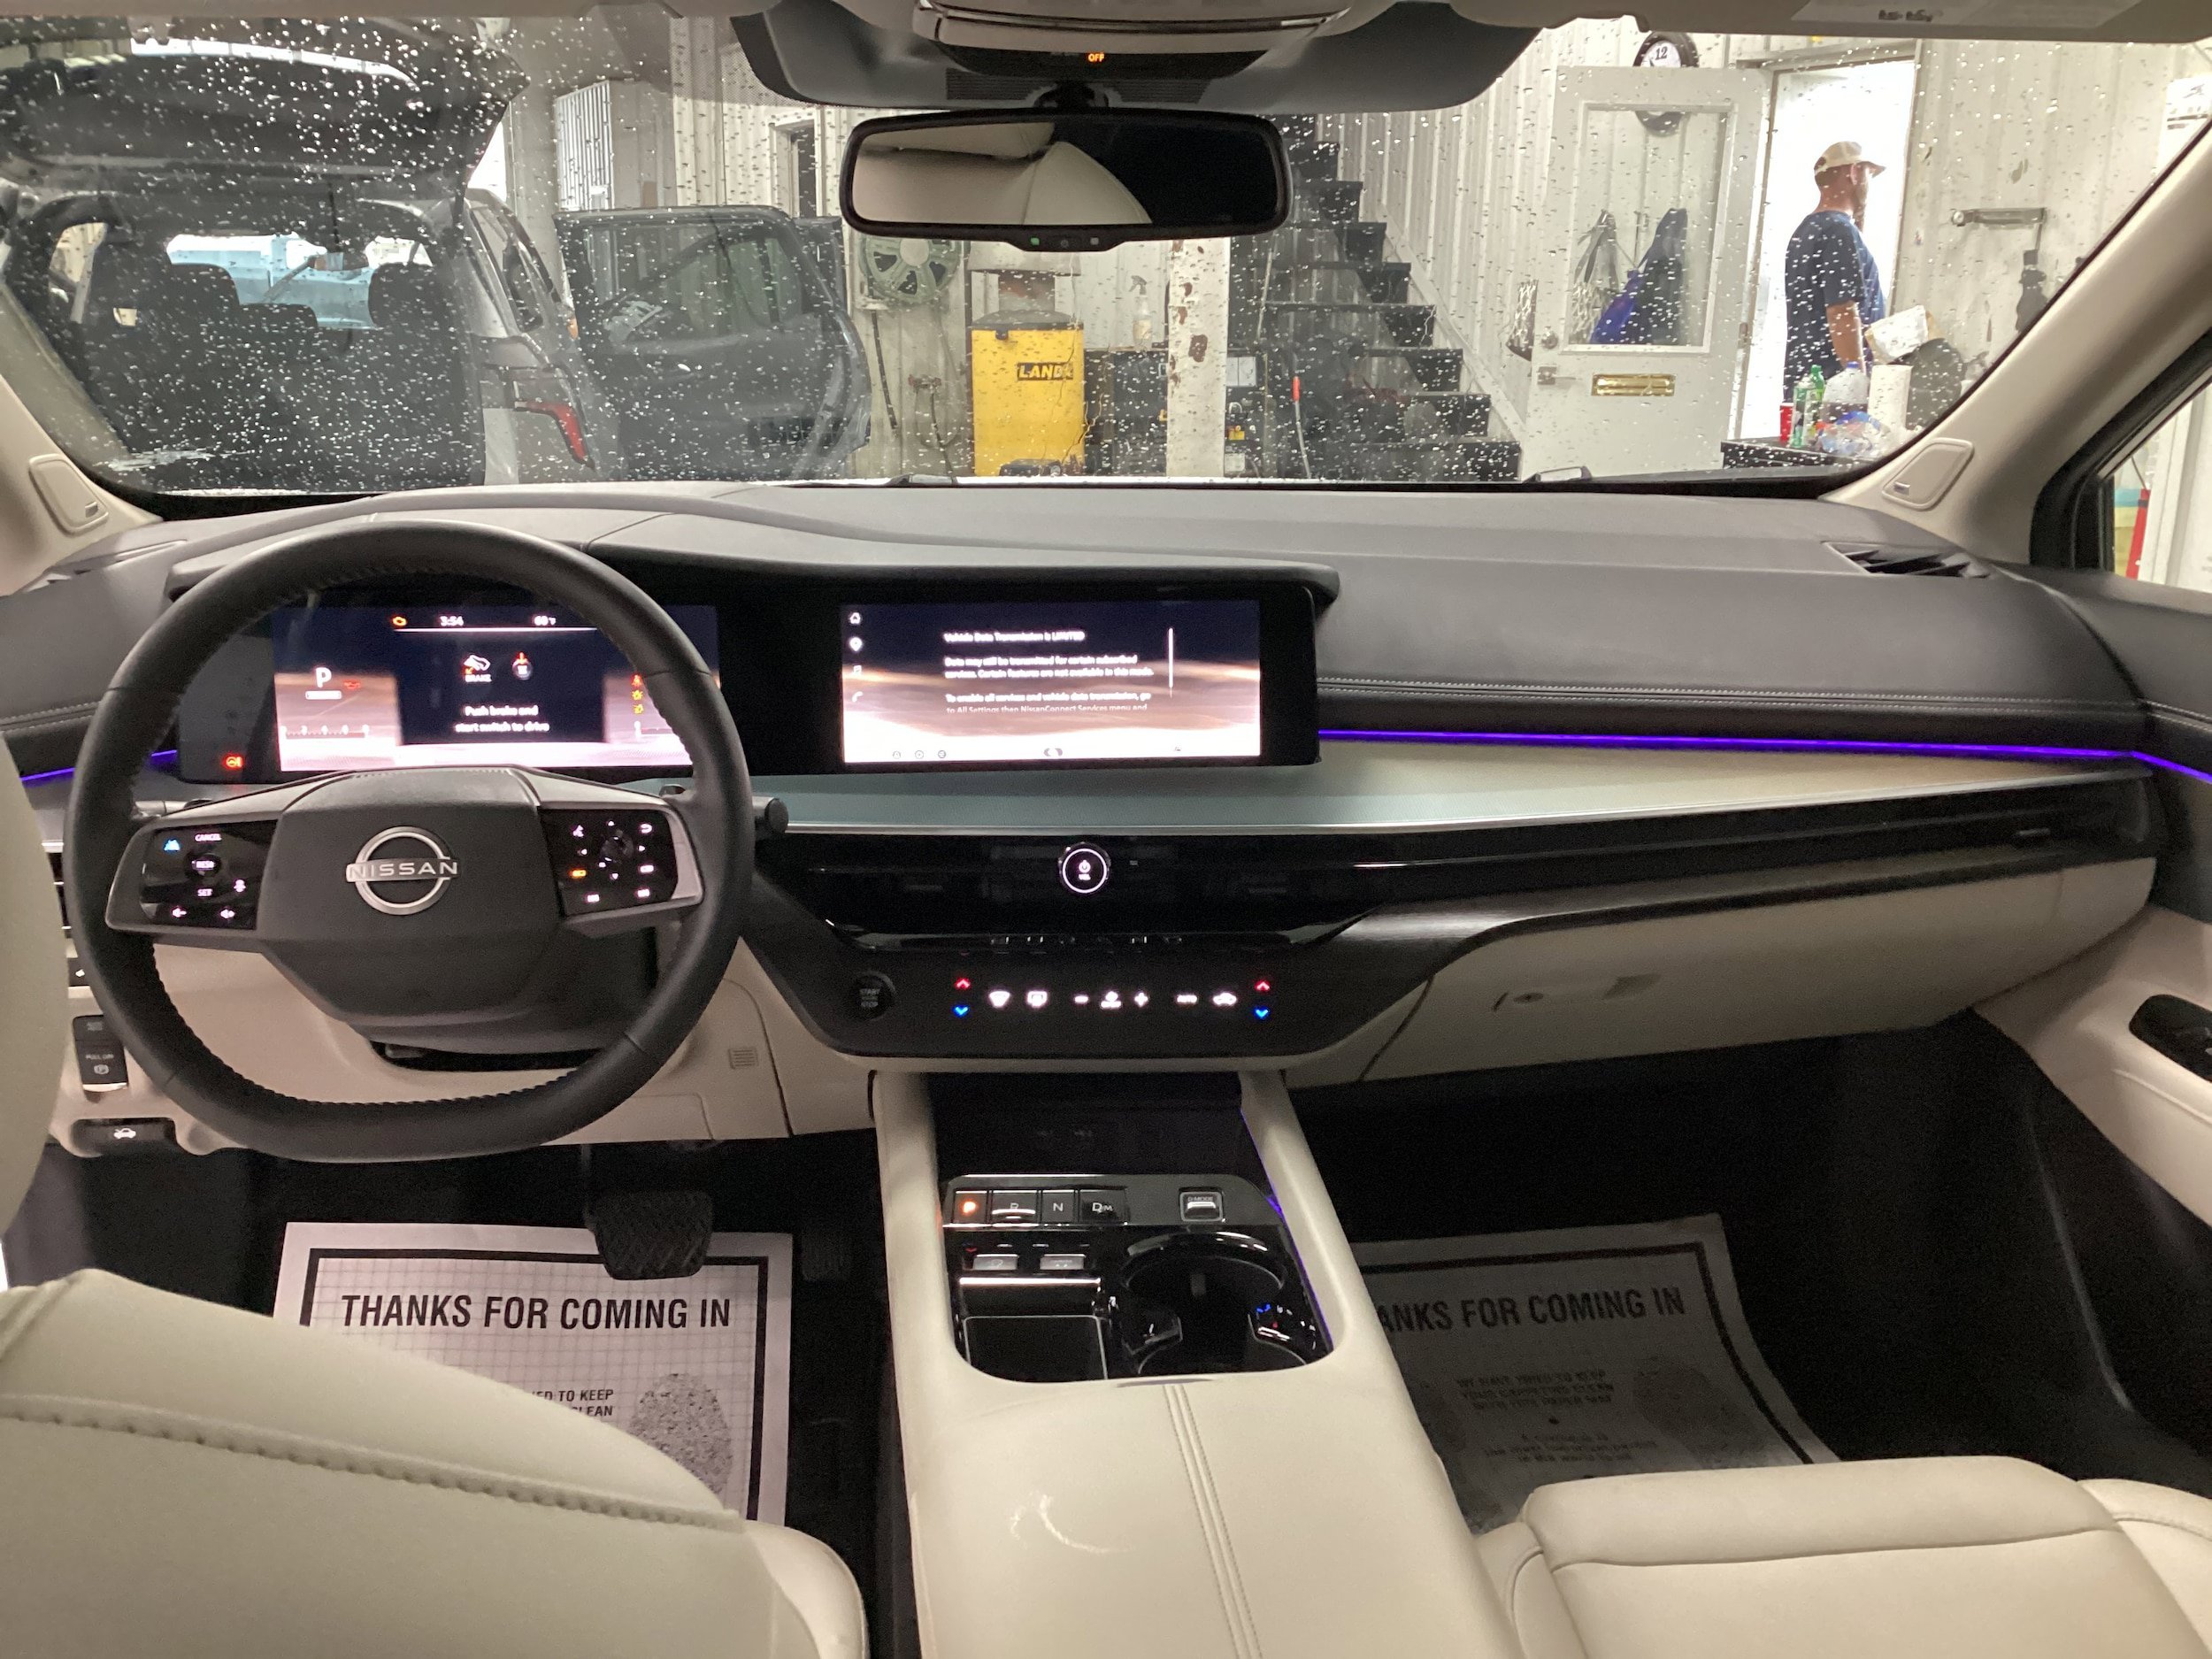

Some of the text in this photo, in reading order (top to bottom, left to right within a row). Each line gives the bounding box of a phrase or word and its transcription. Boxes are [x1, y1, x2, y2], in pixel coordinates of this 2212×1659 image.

[1088, 53, 1105, 62] OFF
[1655, 46, 1669, 60] 12
[315, 666, 332, 687] P
[195, 833, 222, 842] CANCEL
[350, 862, 458, 878] NISSAN
[1053, 1202, 1064, 1211] N
[342, 1294, 730, 1330] THANKS FOR COMING IN
[1377, 1286, 1685, 1333] ANKS FOR COMING IN
[558, 1390, 576, 1402] TO
[580, 1389, 614, 1402] KEEP
[572, 1405, 613, 1417] EAN
